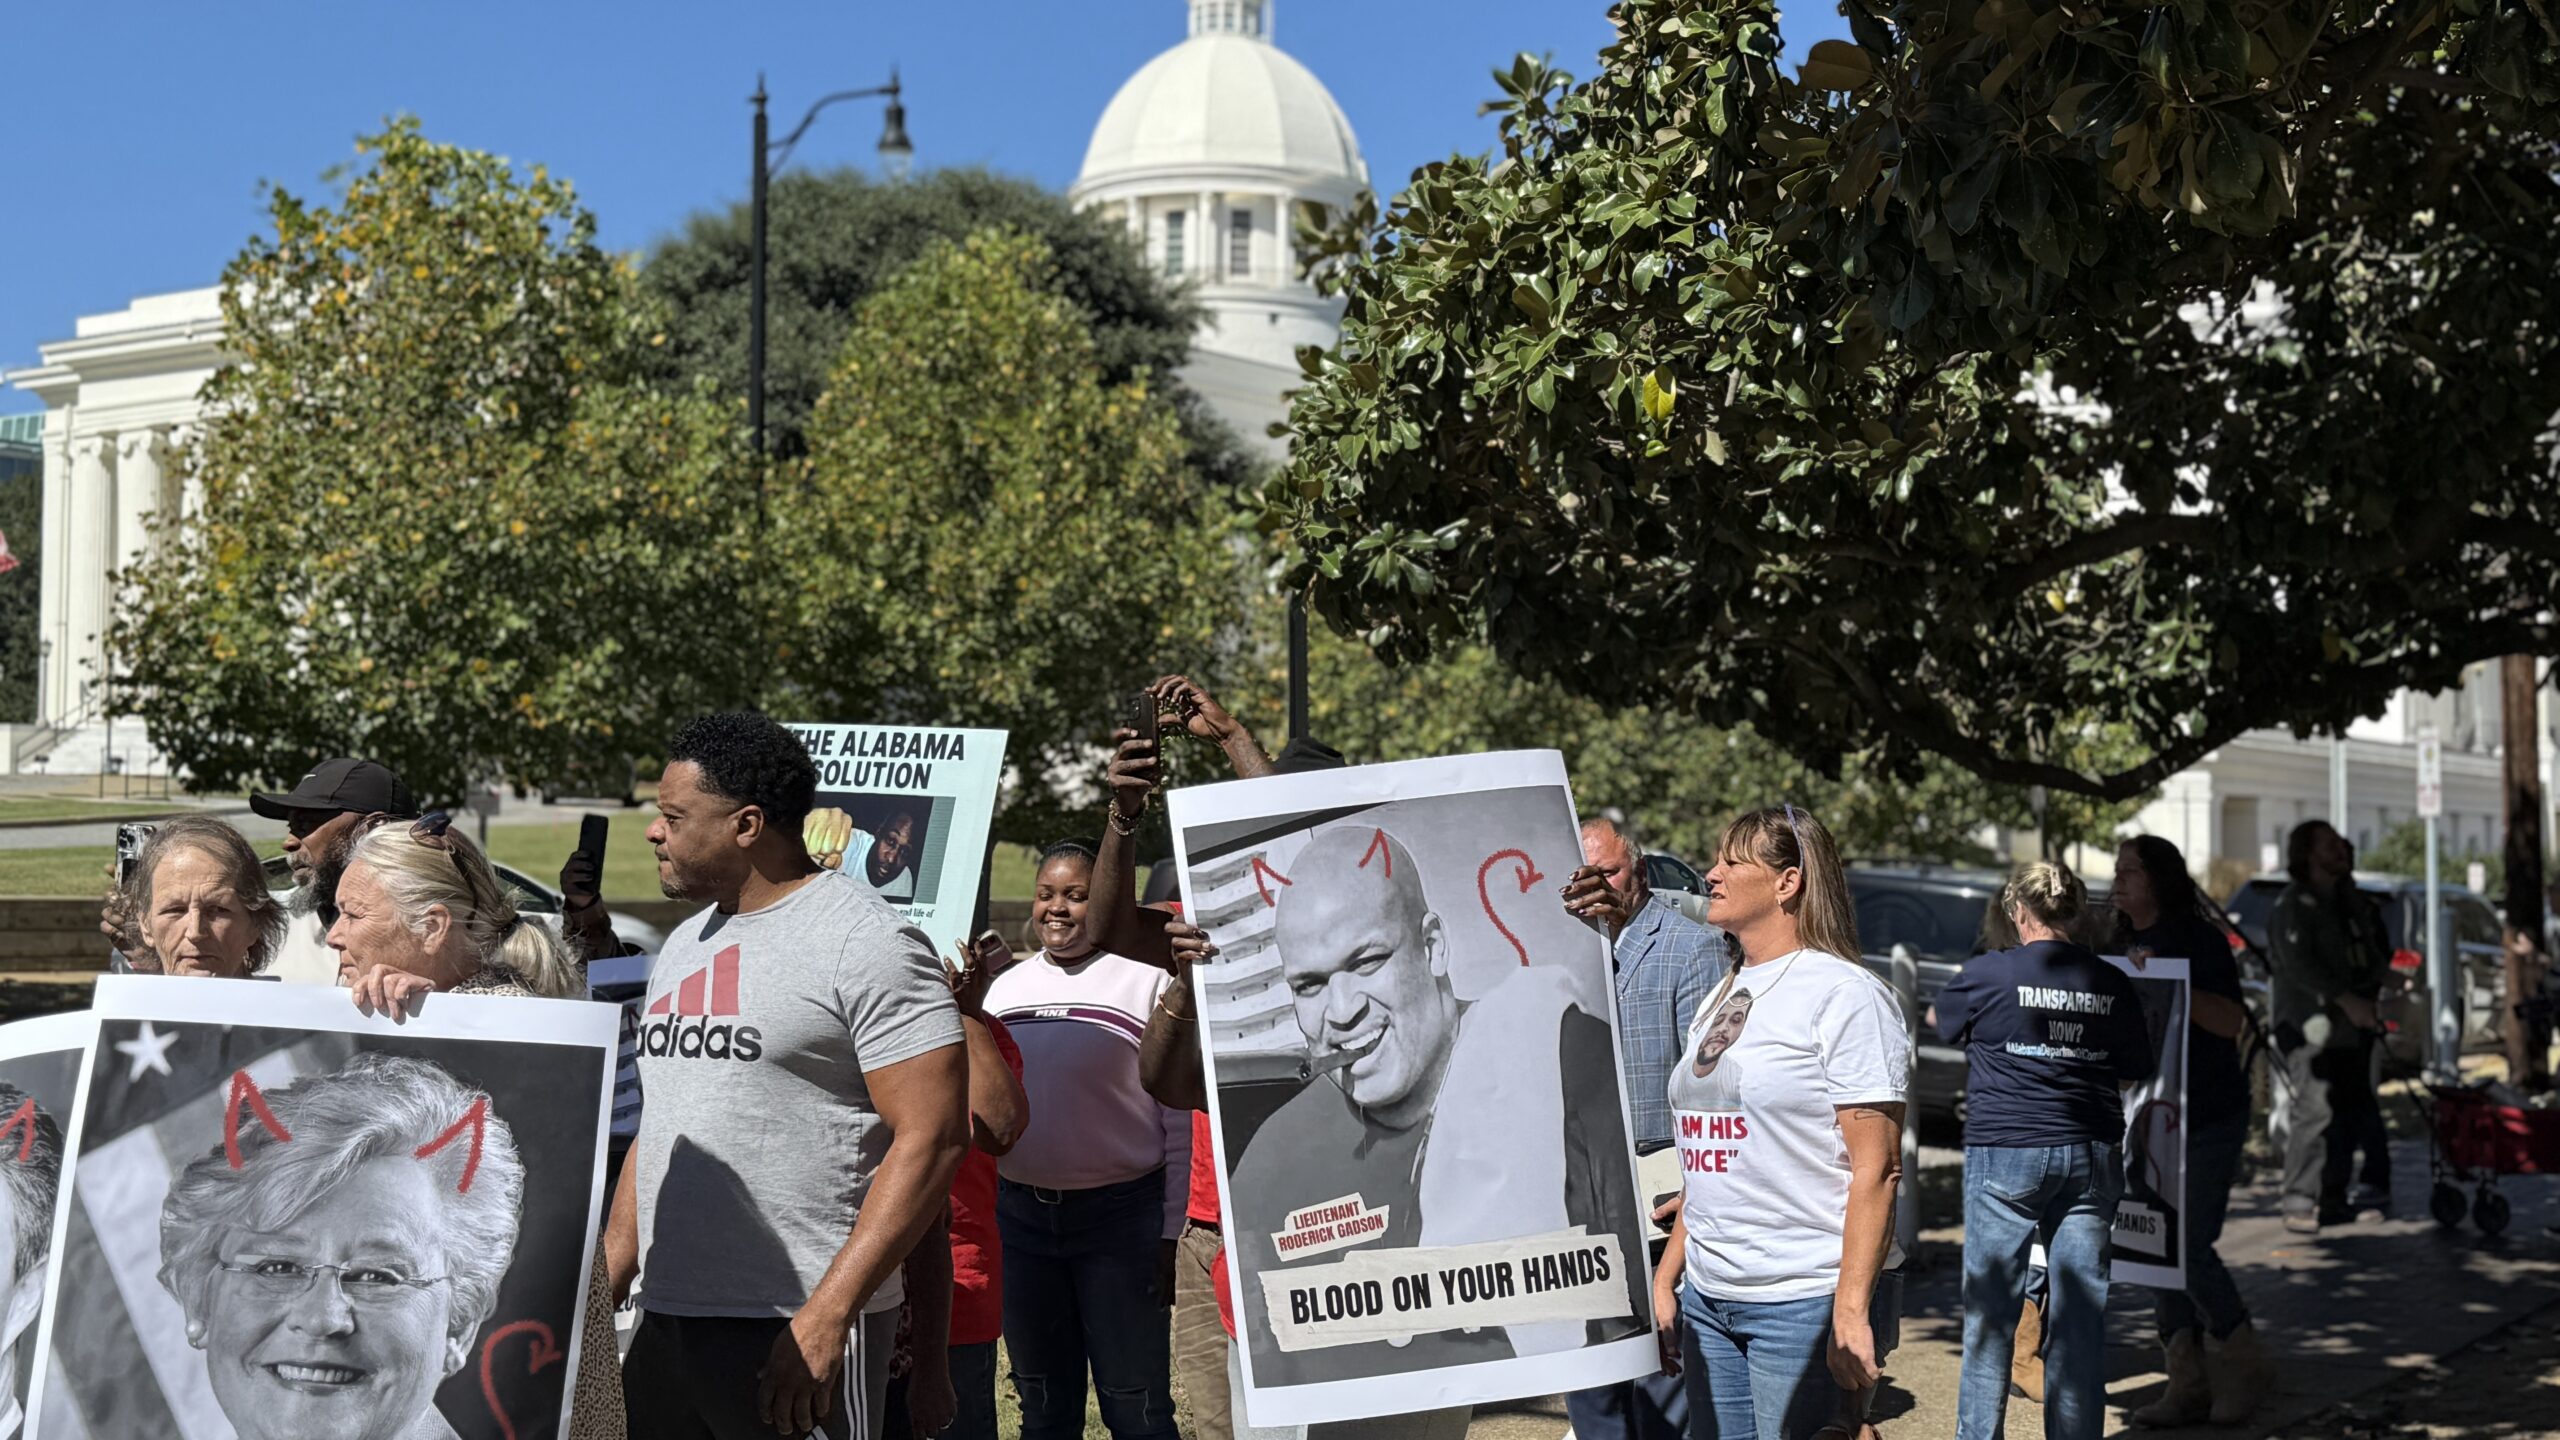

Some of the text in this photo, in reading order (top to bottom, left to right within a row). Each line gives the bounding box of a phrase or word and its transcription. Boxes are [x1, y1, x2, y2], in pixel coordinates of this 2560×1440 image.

[793, 729, 964, 760] THE ALABAMA
[813, 759, 932, 789] SOLUTION
[913, 908, 924, 917] life
[1034, 1008, 1070, 1017] PINK
[2017, 985, 2115, 1016] TRANSPARENCY
[636, 1013, 762, 1062] adidas
[2048, 1020, 2084, 1043] NOW?
[1681, 1115, 1702, 1139] AM
[1709, 1116, 1748, 1140] HIS
[1292, 1200, 1360, 1230] LIEUTENANT
[2115, 1211, 2156, 1235] HANDS
[1277, 1213, 1384, 1252] RODERICK GADSON
[1289, 1245, 1611, 1325] BLOOD ON YOUR HANDS
